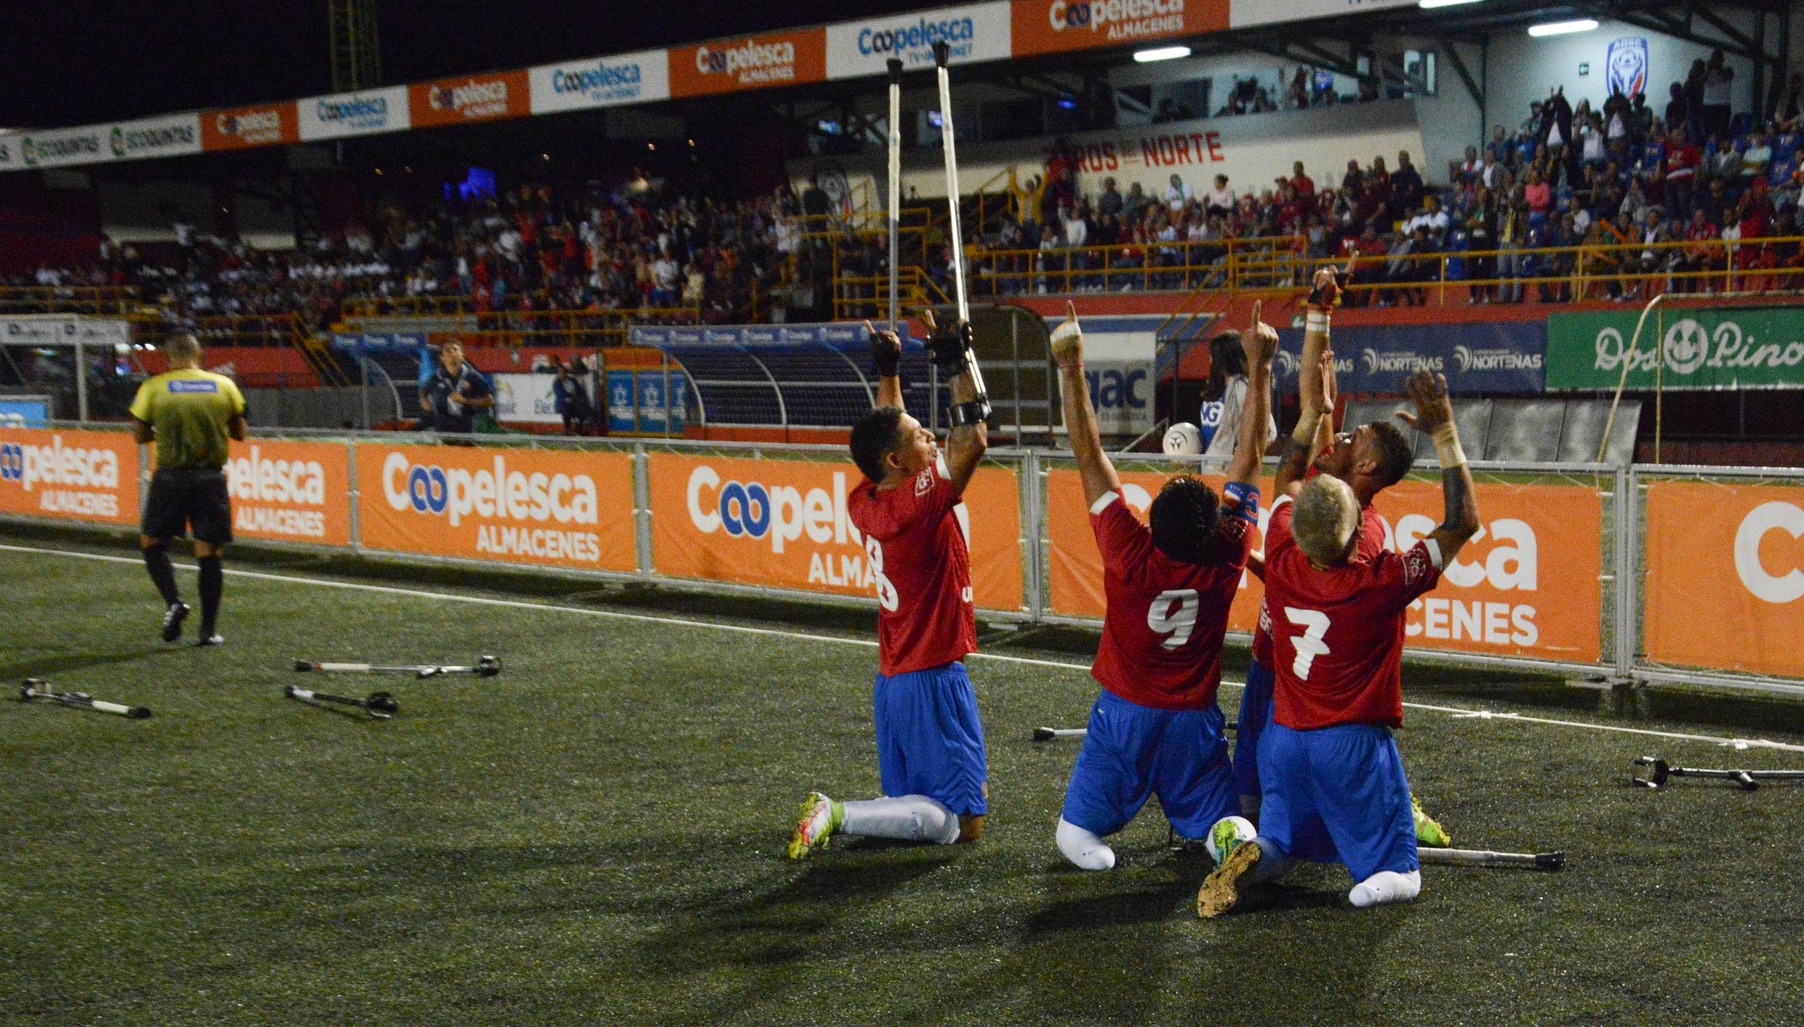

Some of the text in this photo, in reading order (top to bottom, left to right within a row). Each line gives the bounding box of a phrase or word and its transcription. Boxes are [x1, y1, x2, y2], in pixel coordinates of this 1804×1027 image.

[857, 17, 974, 56] Coopelesca
[1107, 15, 1184, 40] ALMACENES
[696, 39, 795, 76] Coopelesca
[553, 61, 641, 94] Coopelesca
[1141, 131, 1224, 168] NORTE
[1595, 327, 1663, 372] Dos
[39, 490, 119, 518] ALMACENES
[382, 451, 598, 528] Coopelesca
[236, 505, 325, 537] ALMACENES
[476, 525, 599, 562] ALMACENES
[865, 534, 899, 612] 8
[1147, 588, 1200, 651] 9
[1404, 597, 1539, 647] CENES
[1284, 606, 1331, 681] 7
